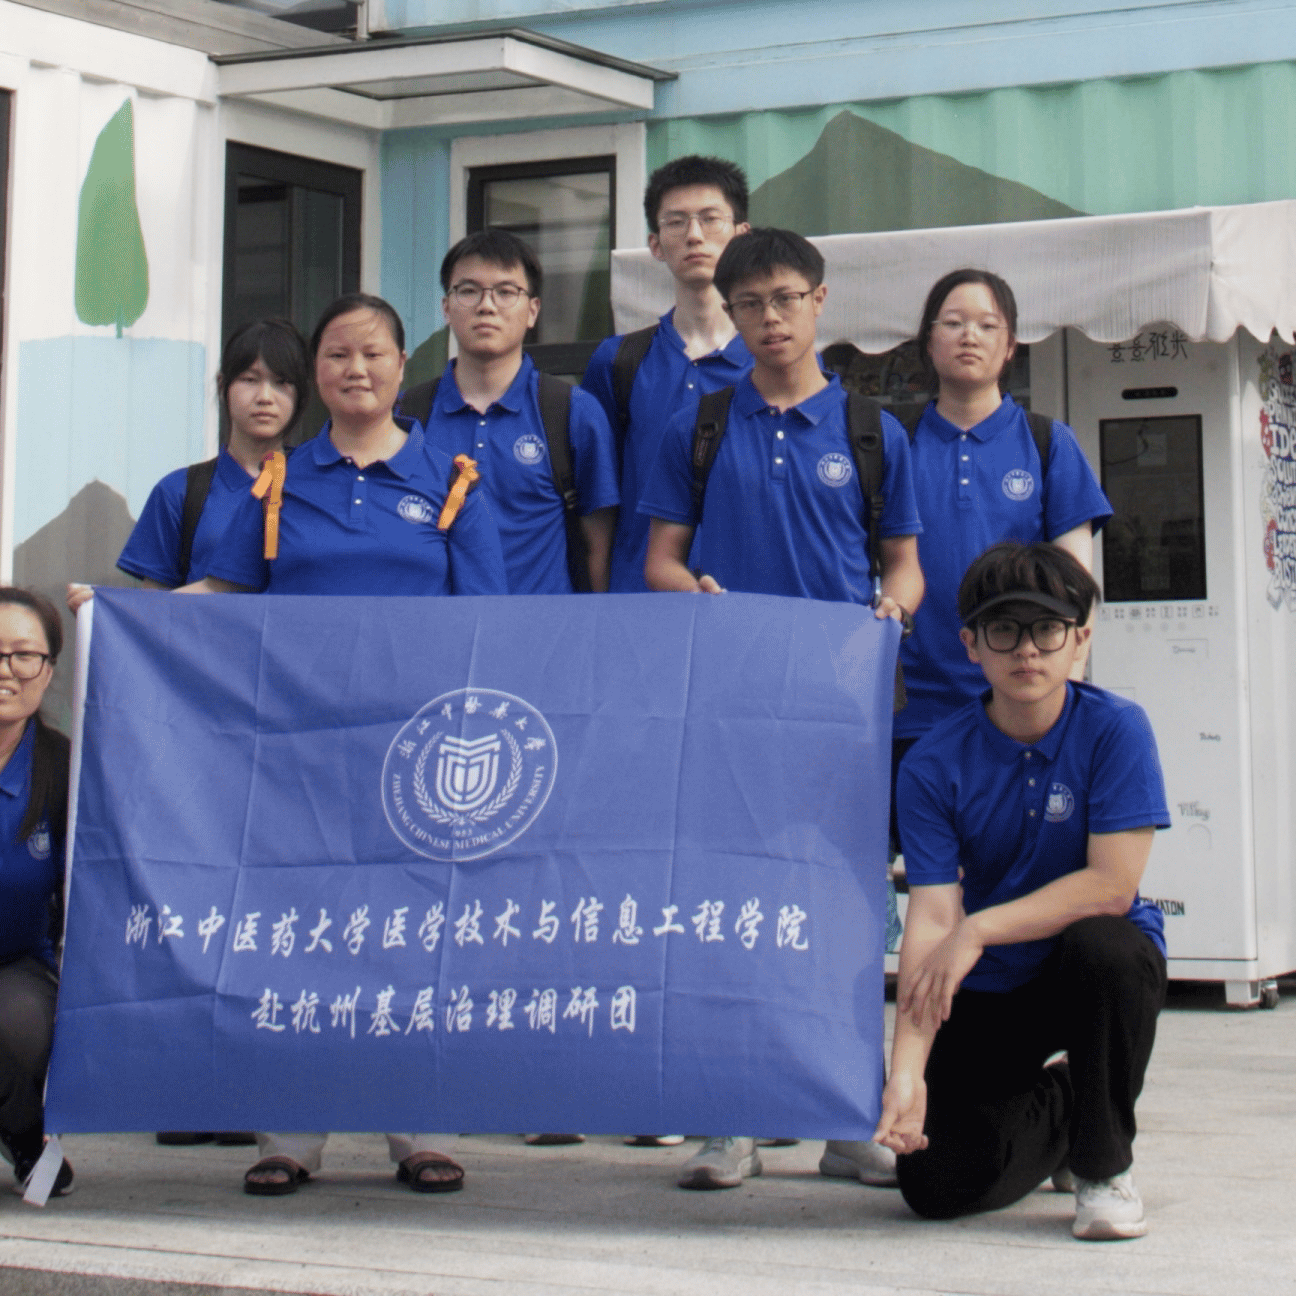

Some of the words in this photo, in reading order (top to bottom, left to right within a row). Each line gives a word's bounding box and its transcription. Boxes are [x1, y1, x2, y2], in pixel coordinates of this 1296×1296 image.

[409, 824, 451, 850] CHINESE
[124, 893, 810, 957] 浙江中医药大学医学技术与信息工程学院
[251, 984, 638, 1038] 赴杭州基层治理调研团
